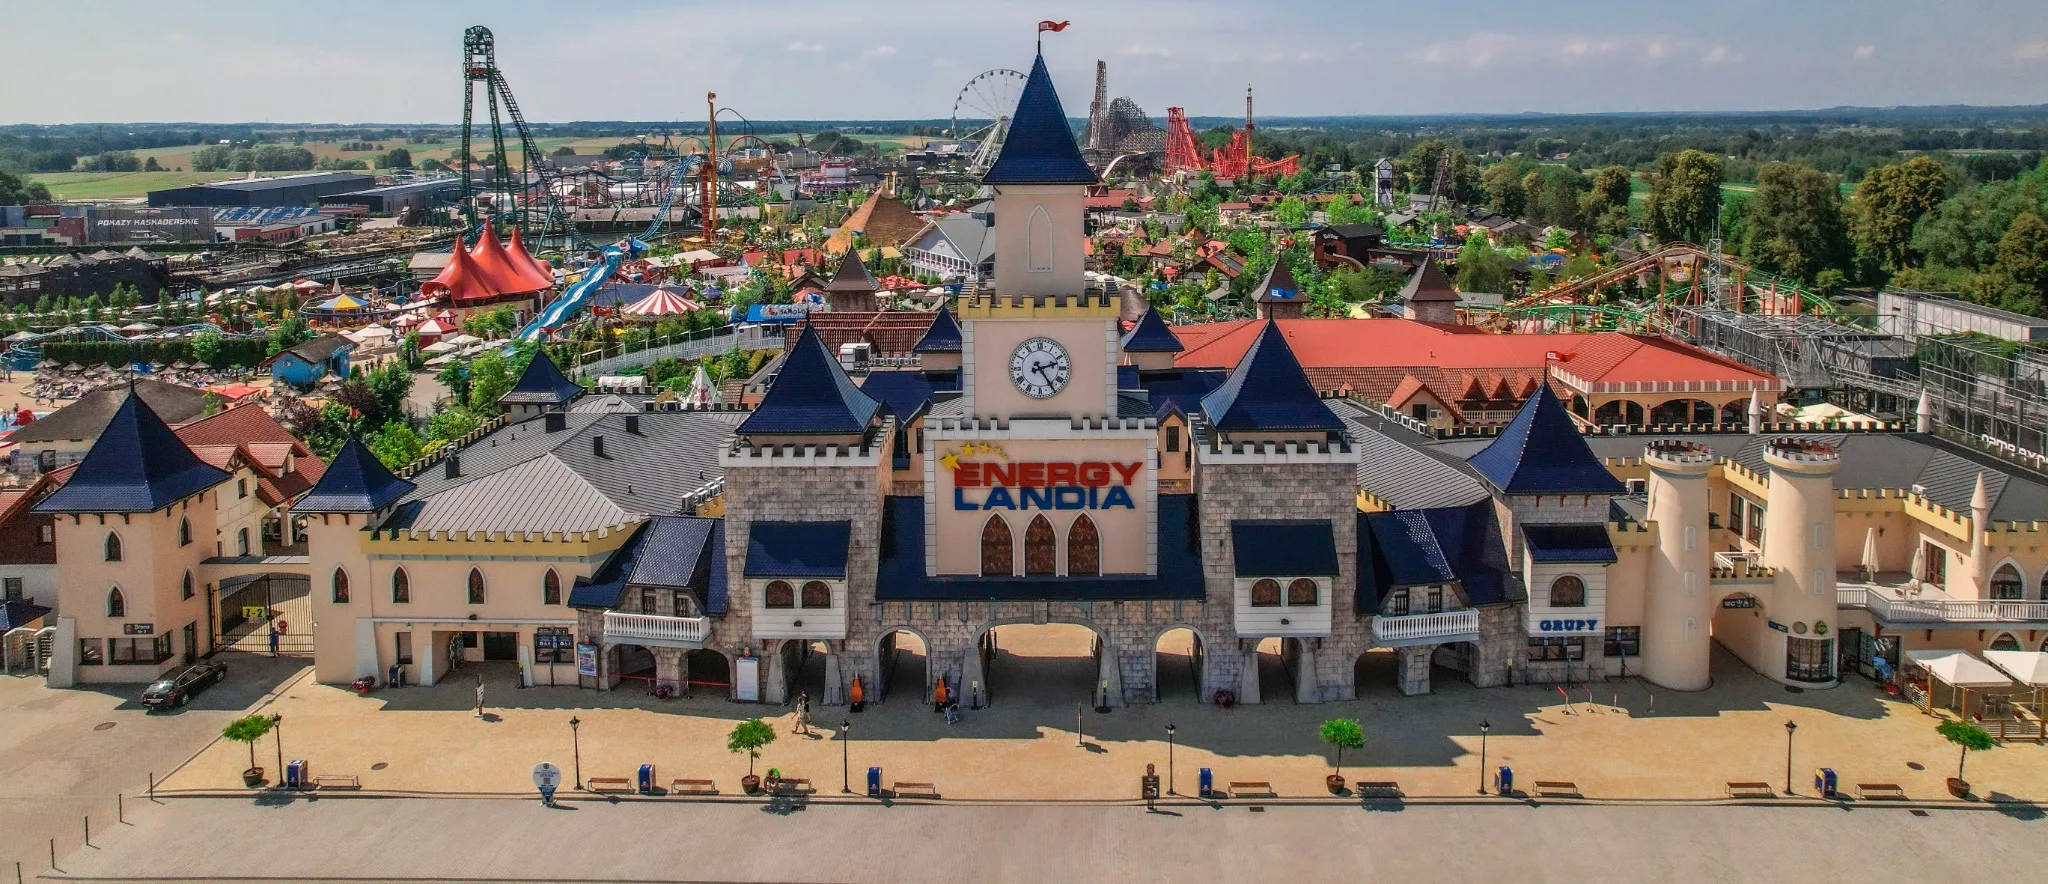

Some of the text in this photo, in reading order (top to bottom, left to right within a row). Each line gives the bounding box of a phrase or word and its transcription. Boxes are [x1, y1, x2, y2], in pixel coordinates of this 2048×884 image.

[97, 218, 199, 227] POKAZY KASKADERSKIE
[1271, 289, 1282, 297] EL
[1546, 352, 1560, 360] EL
[2018, 447, 2048, 469] exp
[954, 461, 1144, 487] ENERGY
[954, 485, 1136, 511] LANDIA
[1540, 619, 1598, 632] GRUPY
